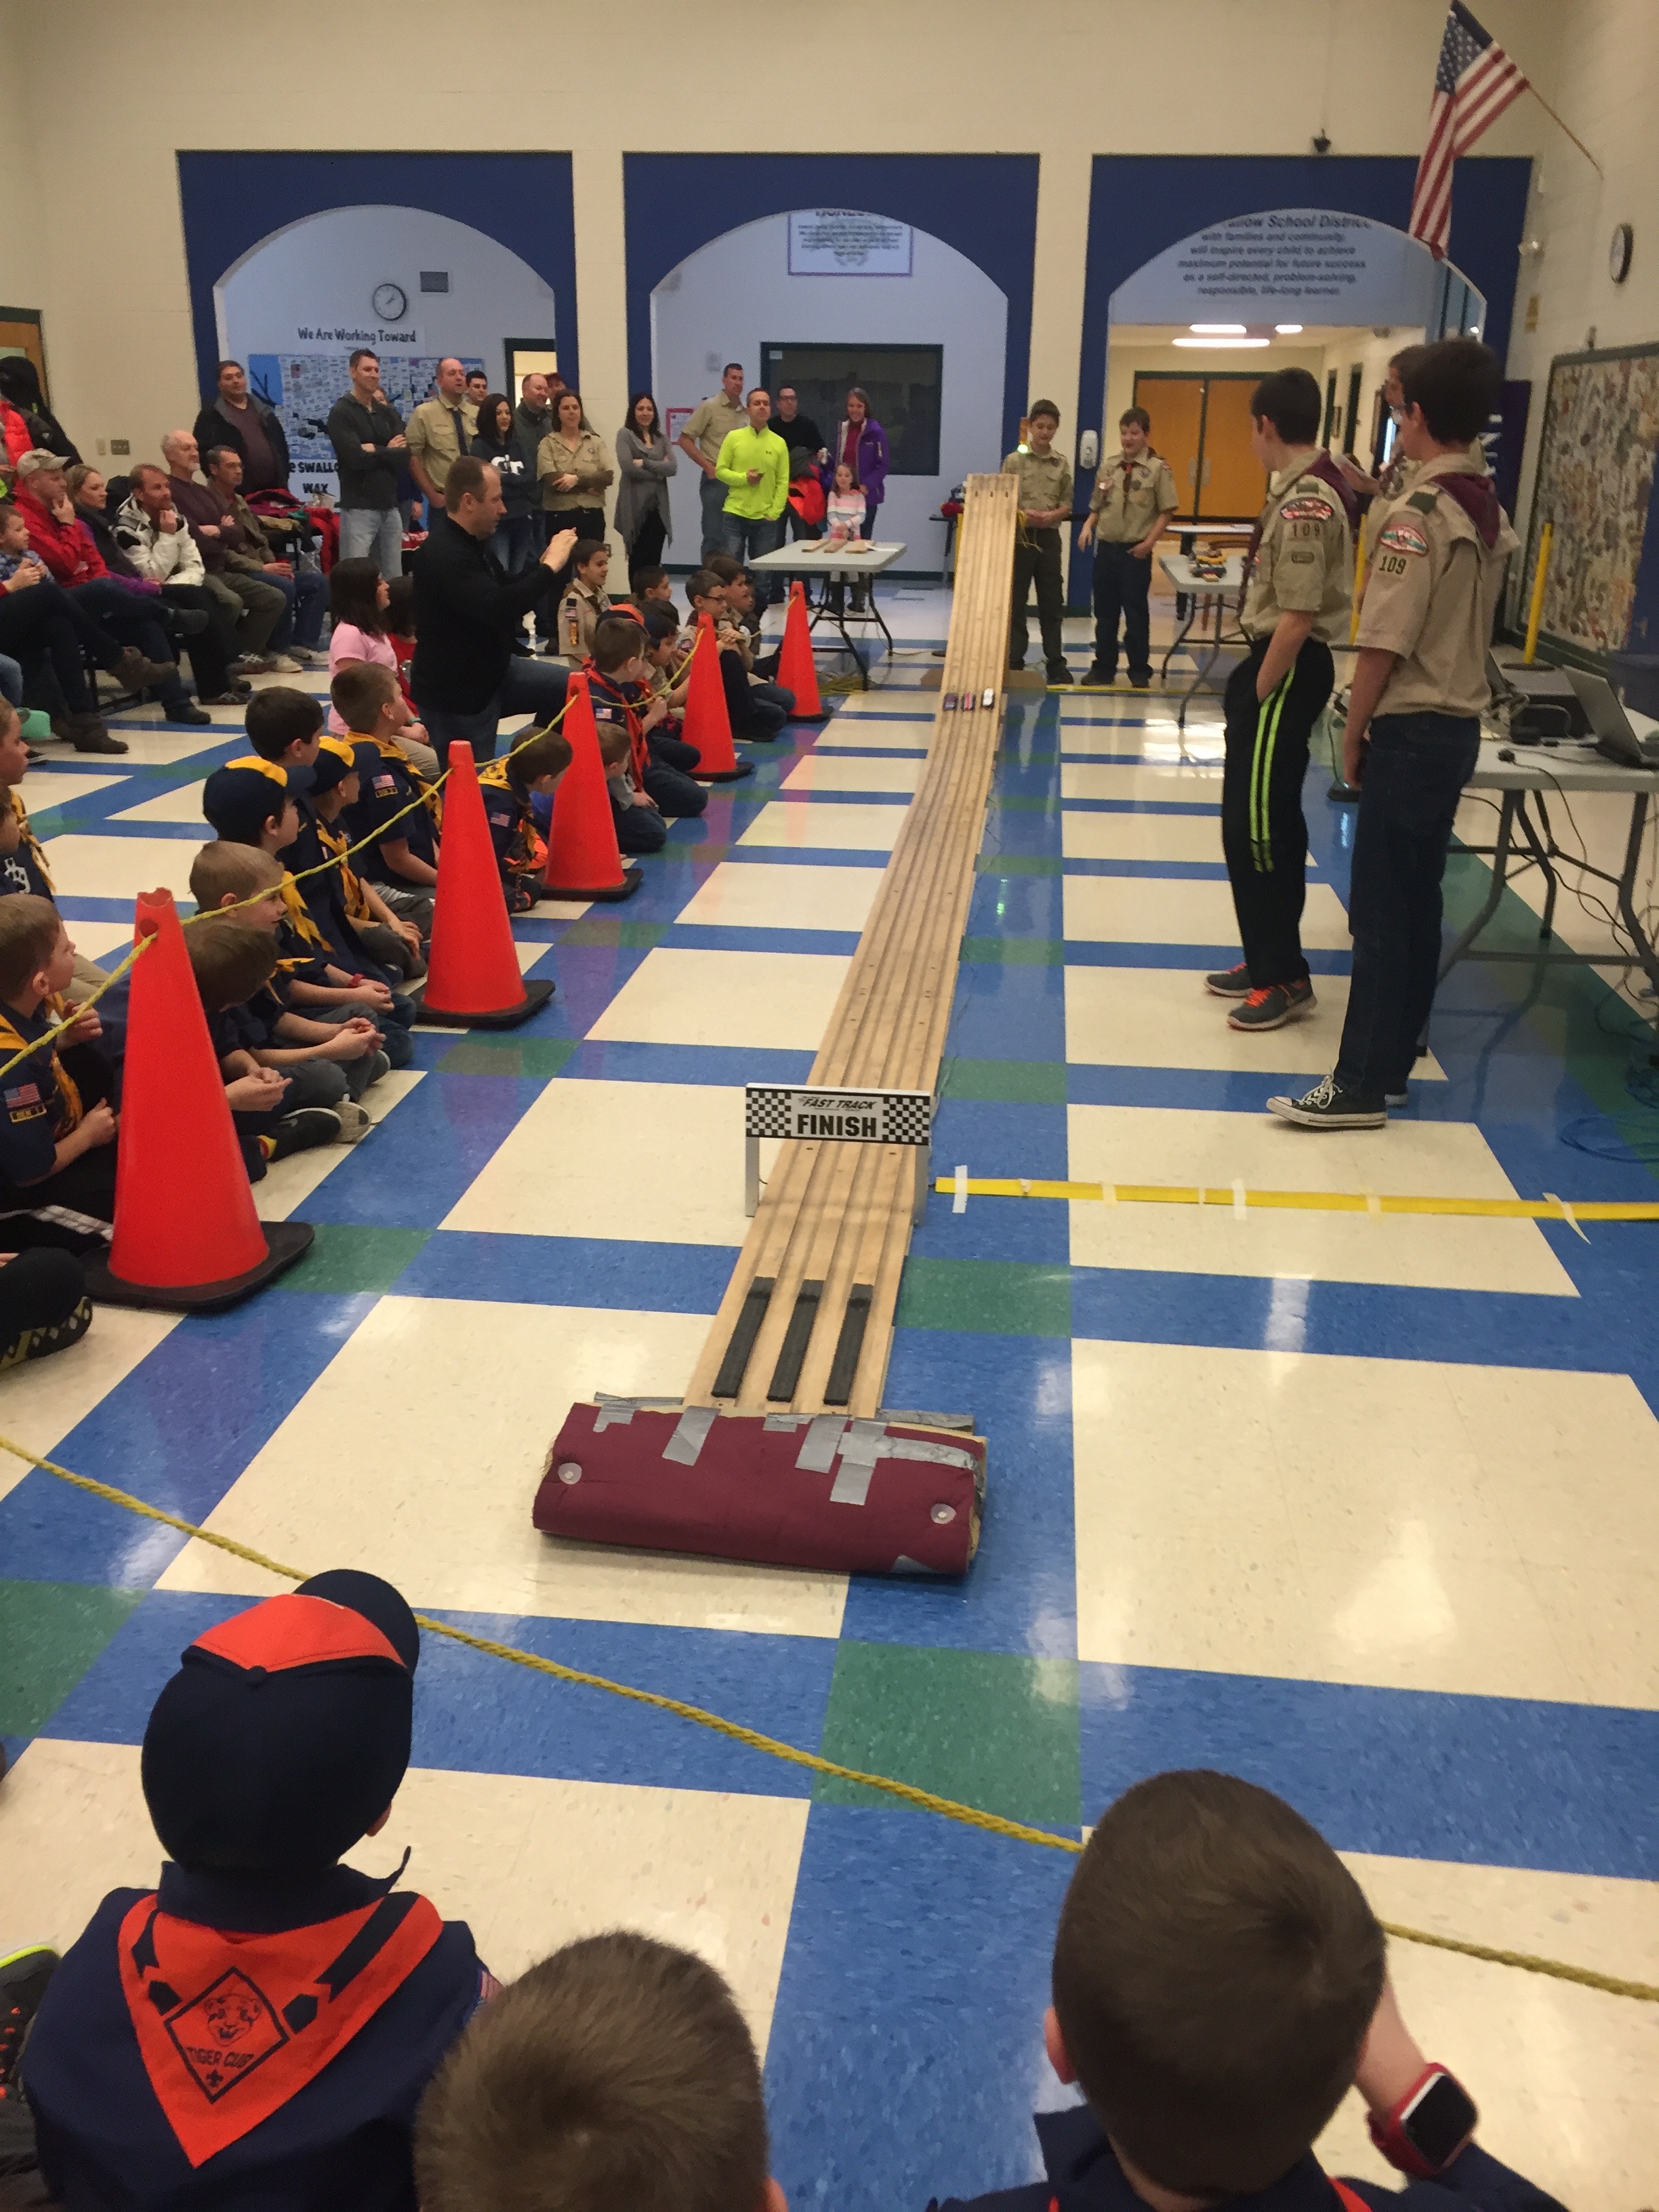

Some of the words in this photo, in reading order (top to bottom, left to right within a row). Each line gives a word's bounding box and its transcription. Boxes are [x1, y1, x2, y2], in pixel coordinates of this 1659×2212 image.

[1268, 215, 1316, 228] School
[298, 327, 314, 340] We
[316, 327, 333, 340] Are
[334, 328, 377, 346] Working
[377, 329, 417, 343] Toward
[302, 483, 328, 494] WAX
[1292, 523, 1321, 537] 109
[1378, 554, 1407, 575] 109
[802, 1099, 835, 1107] FAST
[836, 1100, 877, 1109] TRACK
[797, 1113, 877, 1138] FINISH
[187, 2047, 222, 2066] TIGER
